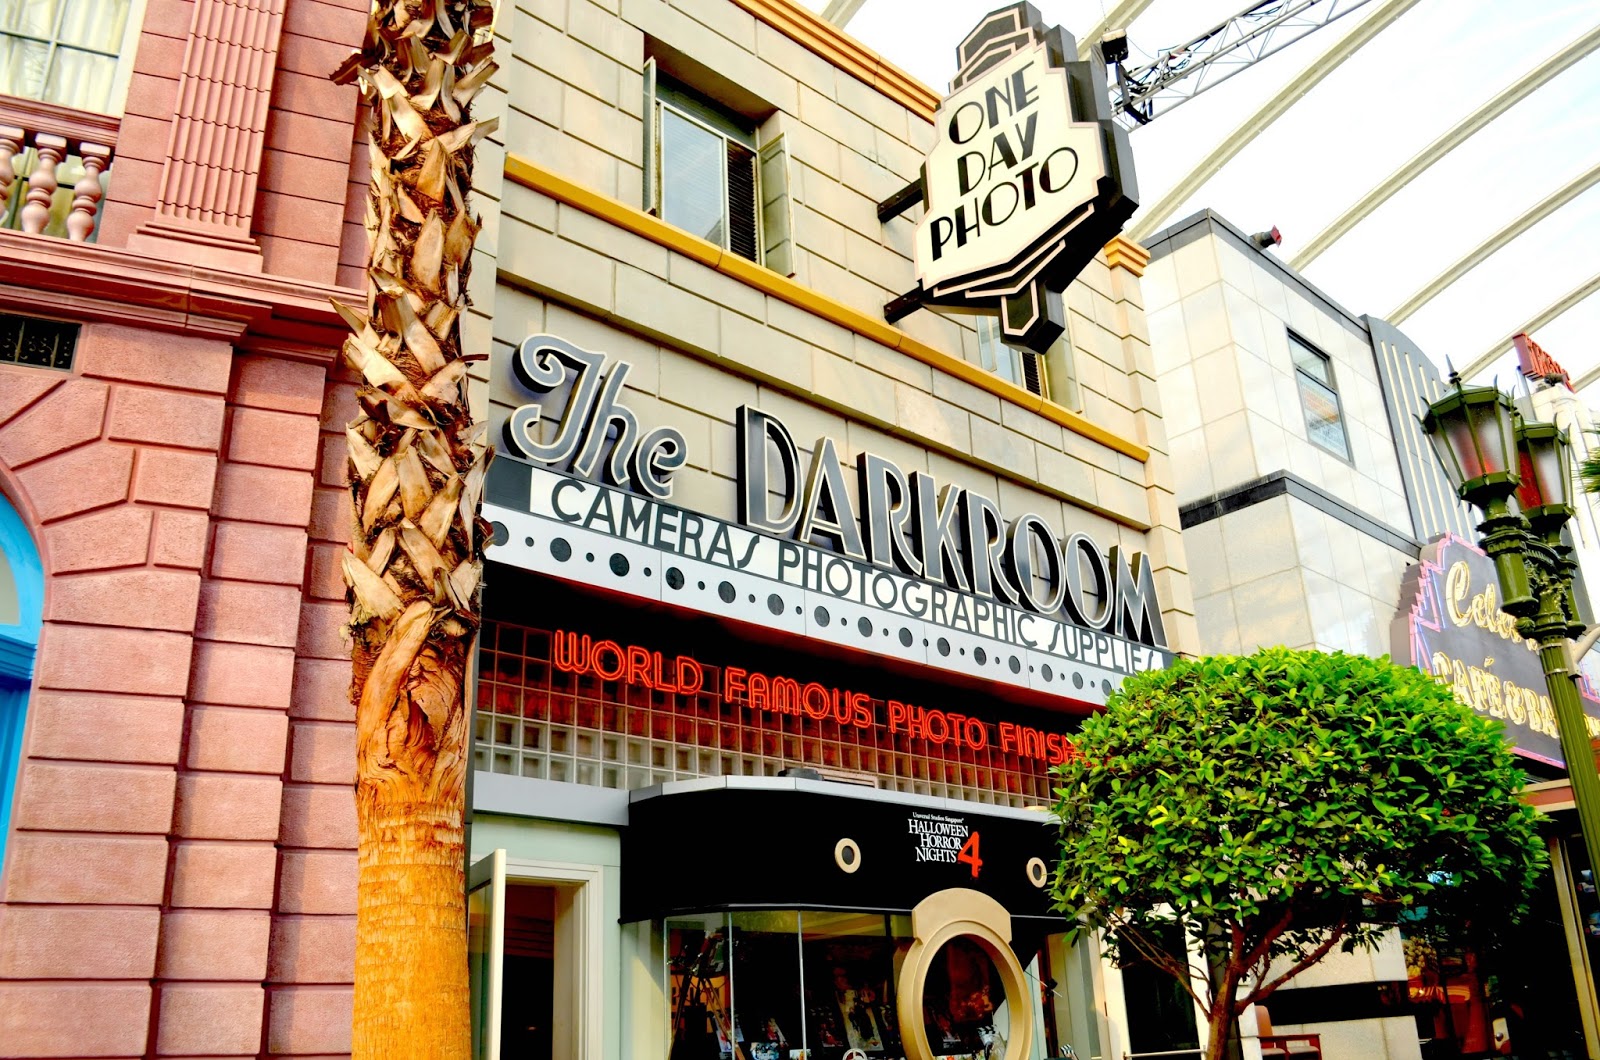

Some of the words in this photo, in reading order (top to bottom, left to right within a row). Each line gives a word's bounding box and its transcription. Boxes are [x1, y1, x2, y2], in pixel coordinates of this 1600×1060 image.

[949, 61, 1040, 145] ONE
[957, 110, 1039, 198] DAY
[929, 146, 1079, 262] PHOTO
[503, 333, 688, 499] The
[736, 403, 1169, 649] DARKROOM
[551, 478, 760, 569] CAMERAS
[778, 540, 1038, 648] PHOTOGRAPHIC
[555, 629, 703, 695] WORLD
[725, 666, 872, 728] FAMOUS
[888, 701, 986, 750] PHOTO
[908, 818, 969, 837] HALLOWEEN
[915, 846, 958, 863] NIGHTS
[958, 831, 983, 877] 4
[920, 833, 964, 850] HORROR
